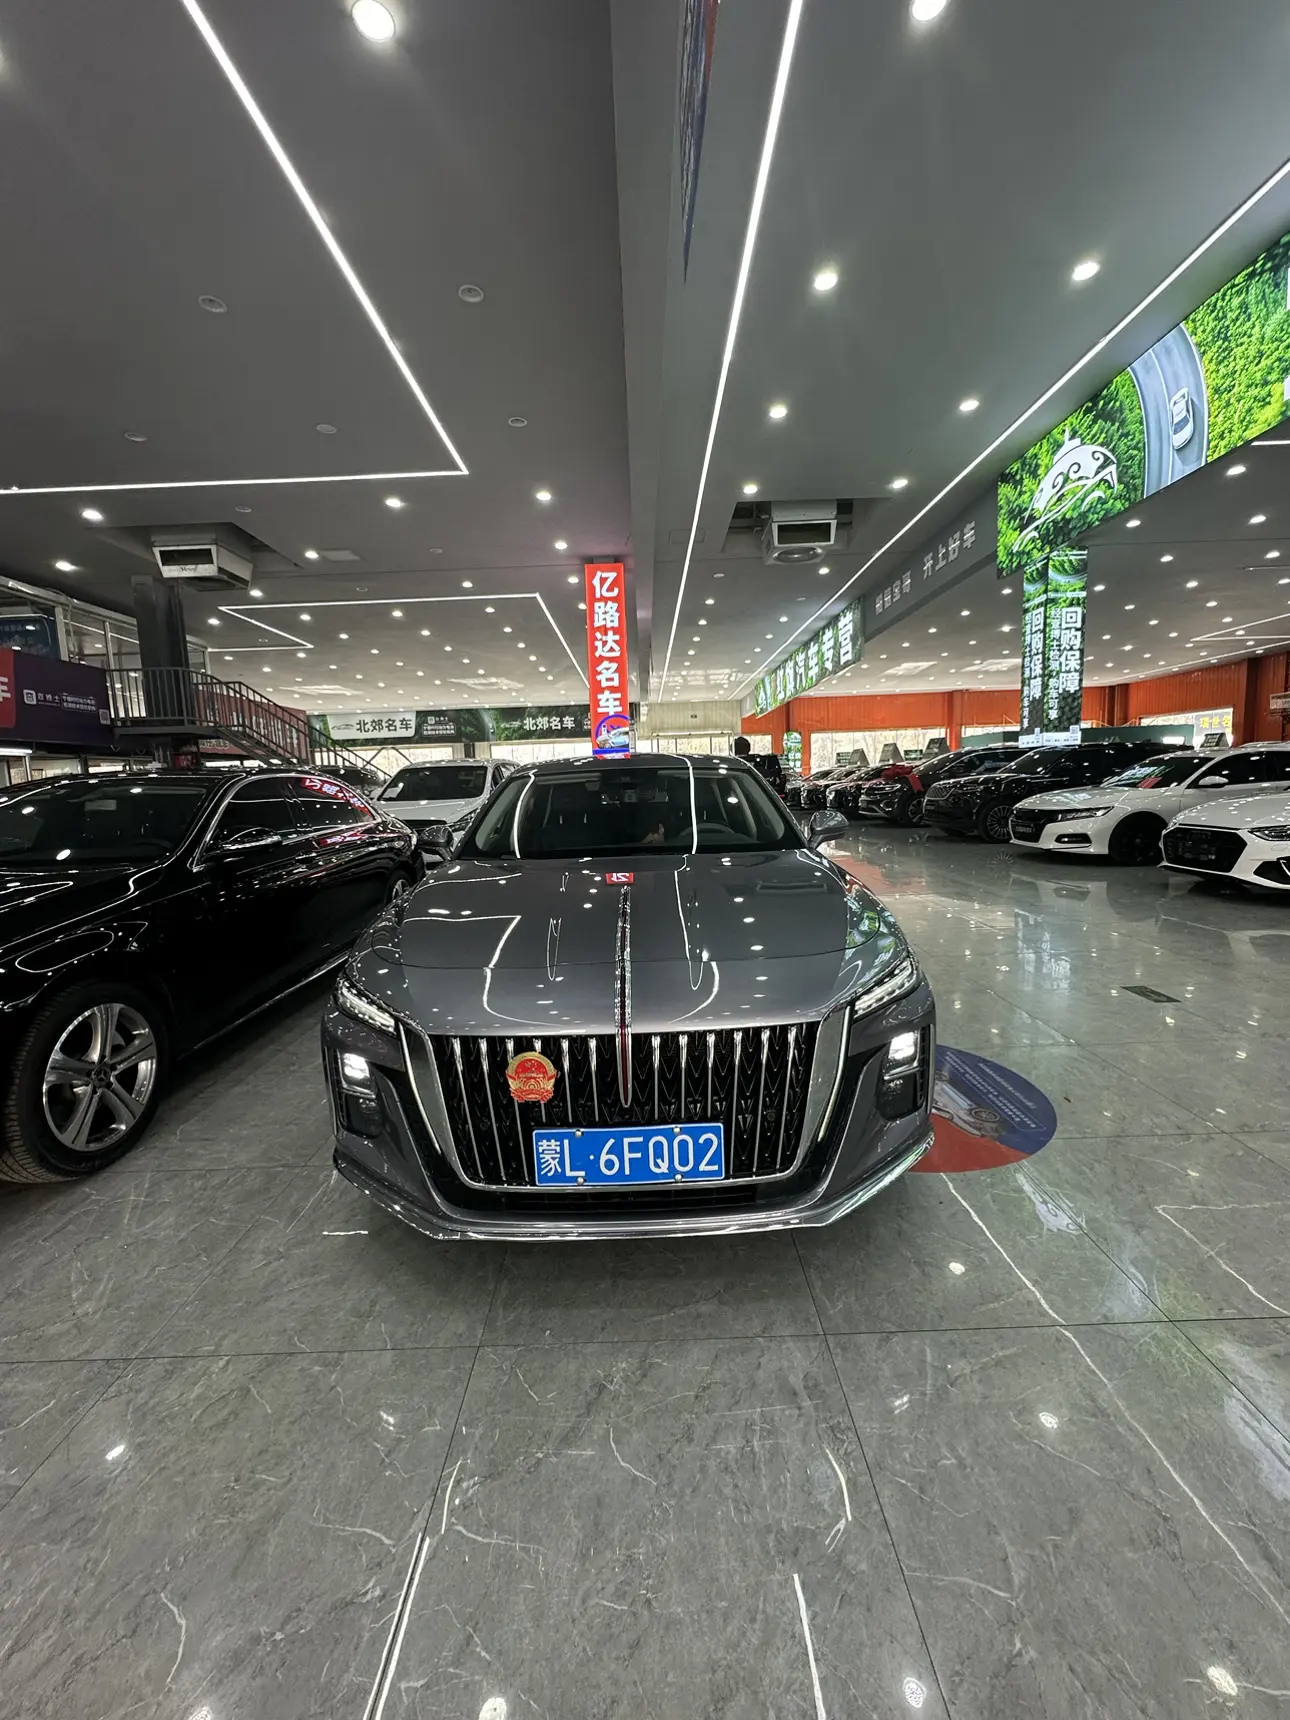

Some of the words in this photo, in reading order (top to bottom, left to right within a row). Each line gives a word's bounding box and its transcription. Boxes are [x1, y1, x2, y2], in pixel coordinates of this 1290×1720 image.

[922, 520, 976, 580] 开上好车
[592, 570, 623, 716] 亿路达名车
[1058, 607, 1082, 694] 回购保障
[355, 716, 413, 734] 北郊名车
[522, 715, 576, 731] 北郊名车
[537, 1132, 720, 1178] 蒙L·6FQ02
